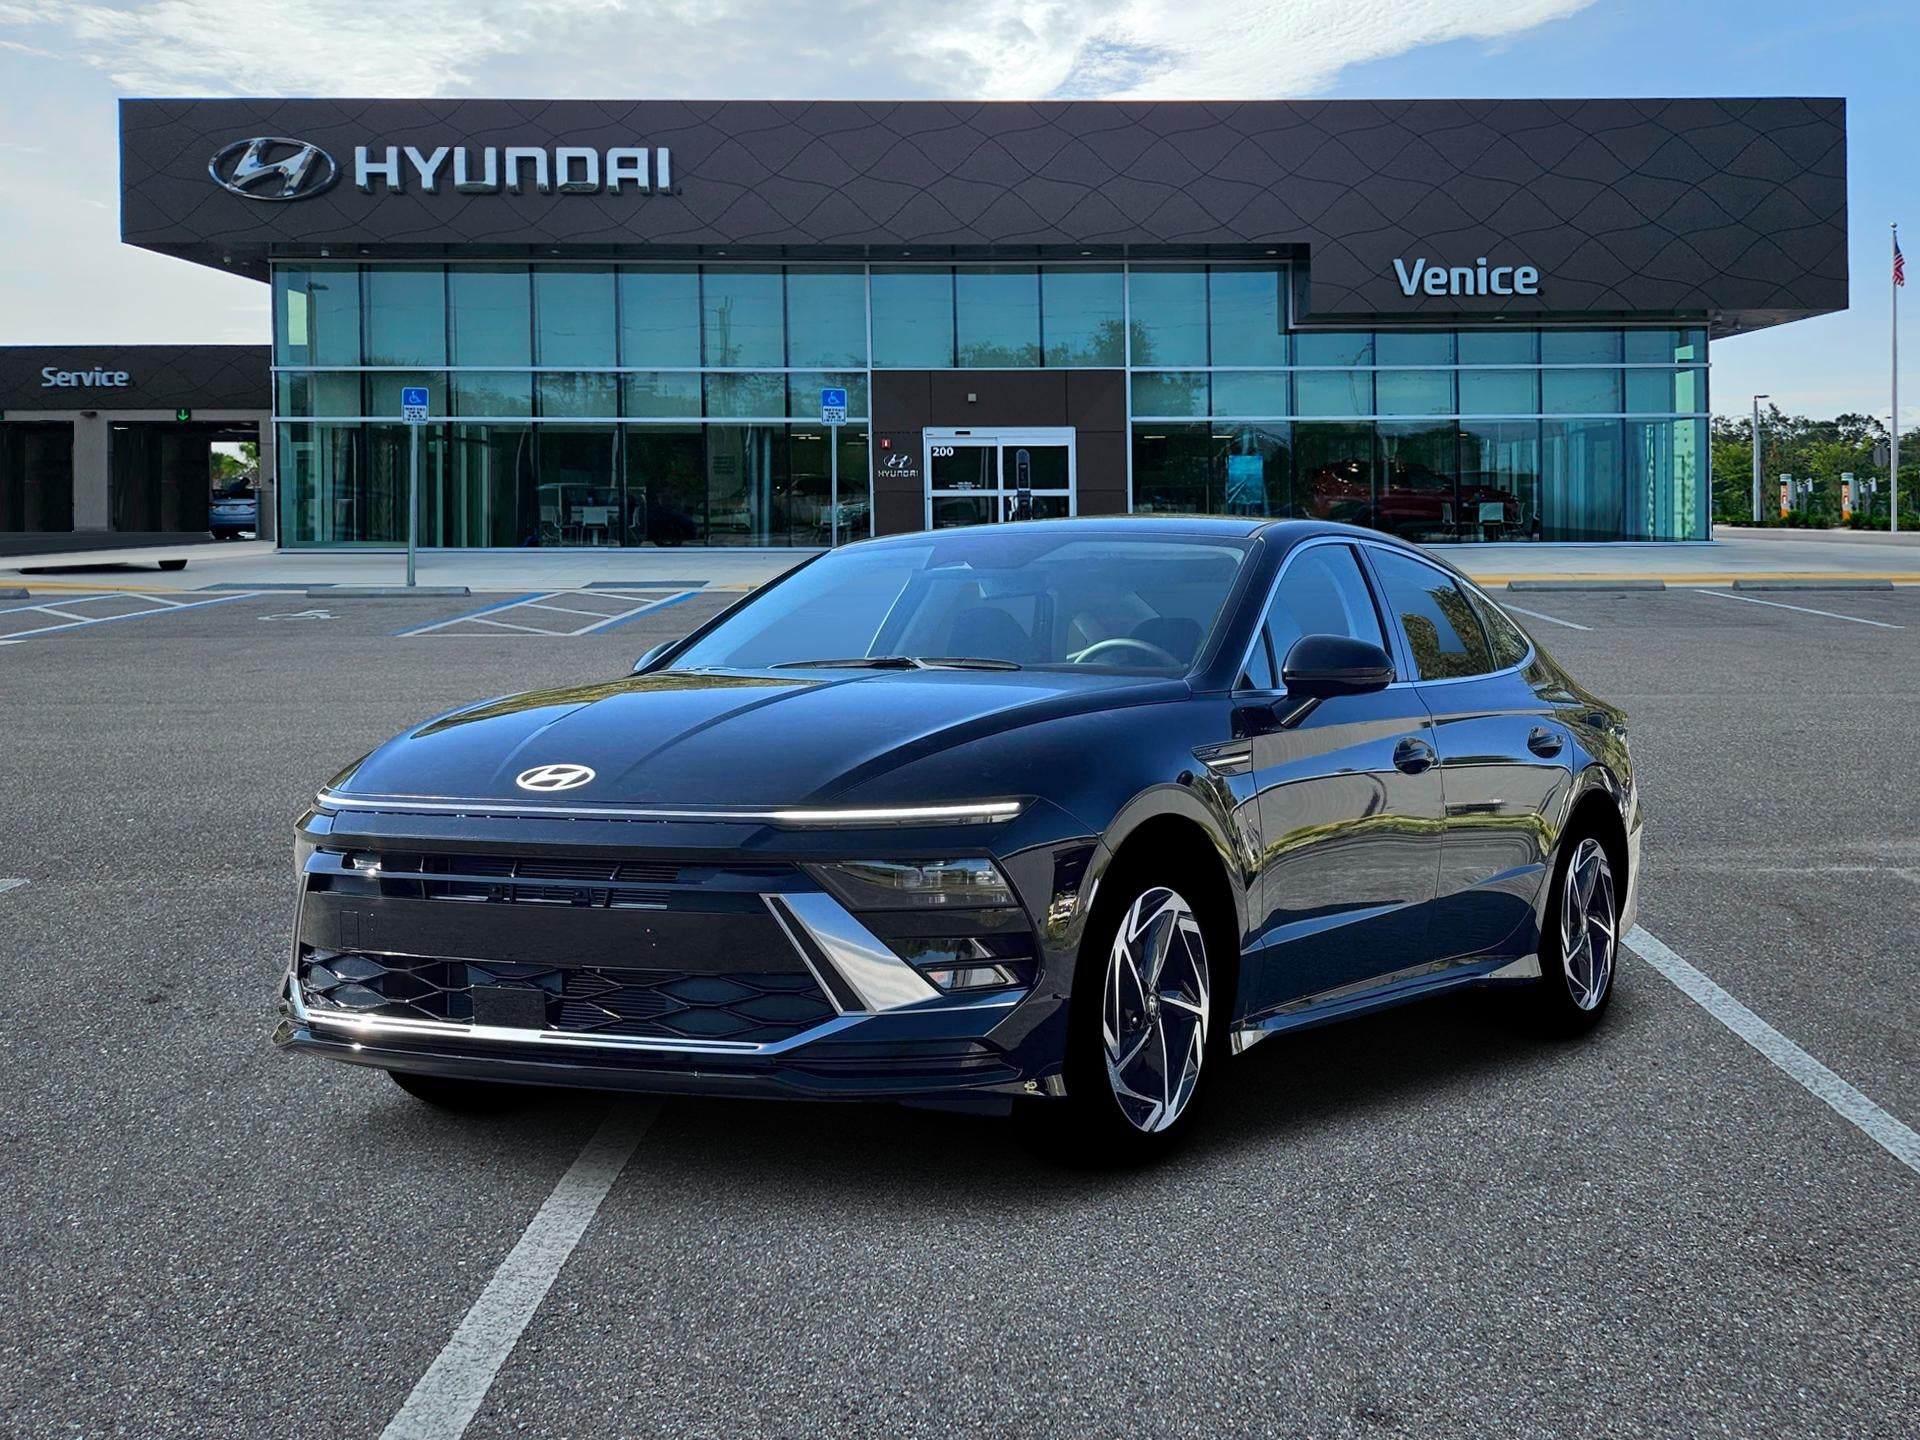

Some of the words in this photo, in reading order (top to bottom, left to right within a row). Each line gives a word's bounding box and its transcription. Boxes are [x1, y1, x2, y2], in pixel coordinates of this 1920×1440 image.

[354, 146, 672, 193] HYUNDAI
[1393, 257, 1539, 295] Venice
[41, 366, 130, 387] Service
[932, 447, 954, 456] 200
